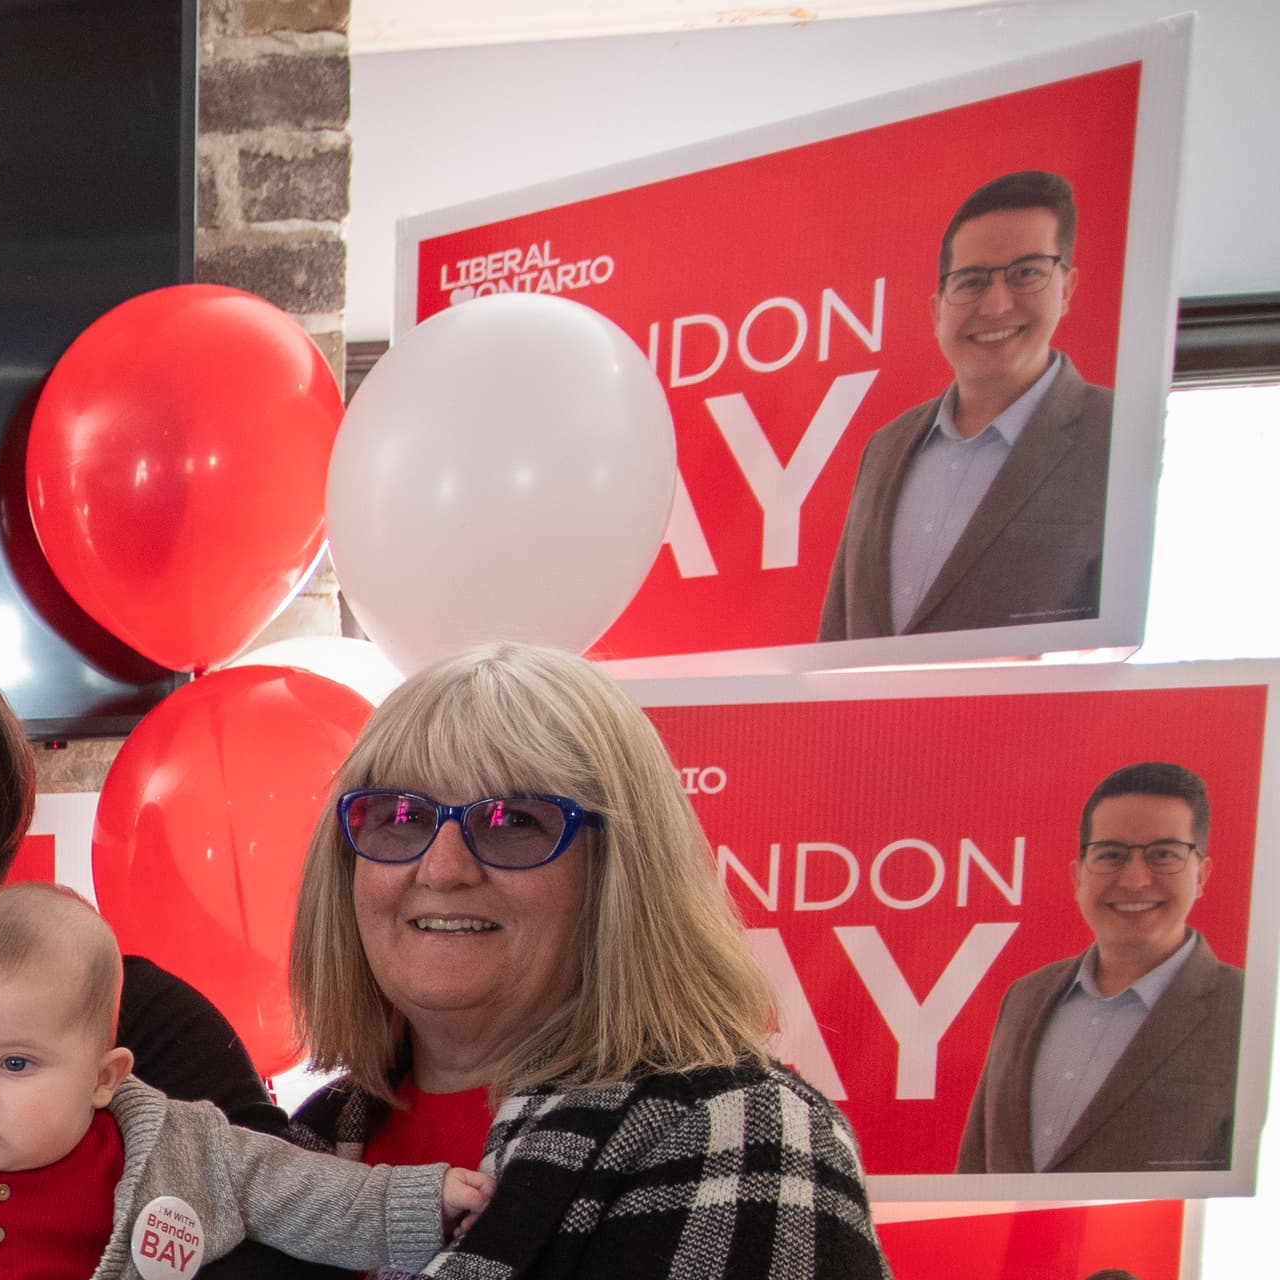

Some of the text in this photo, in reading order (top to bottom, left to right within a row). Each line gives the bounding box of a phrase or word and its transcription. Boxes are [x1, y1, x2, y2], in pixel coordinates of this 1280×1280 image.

[440, 240, 560, 291] LIBERAL
[147, 1213, 200, 1247] Brandon
[174, 1212, 195, 1228] WITH
[139, 1229, 197, 1272] BAY
